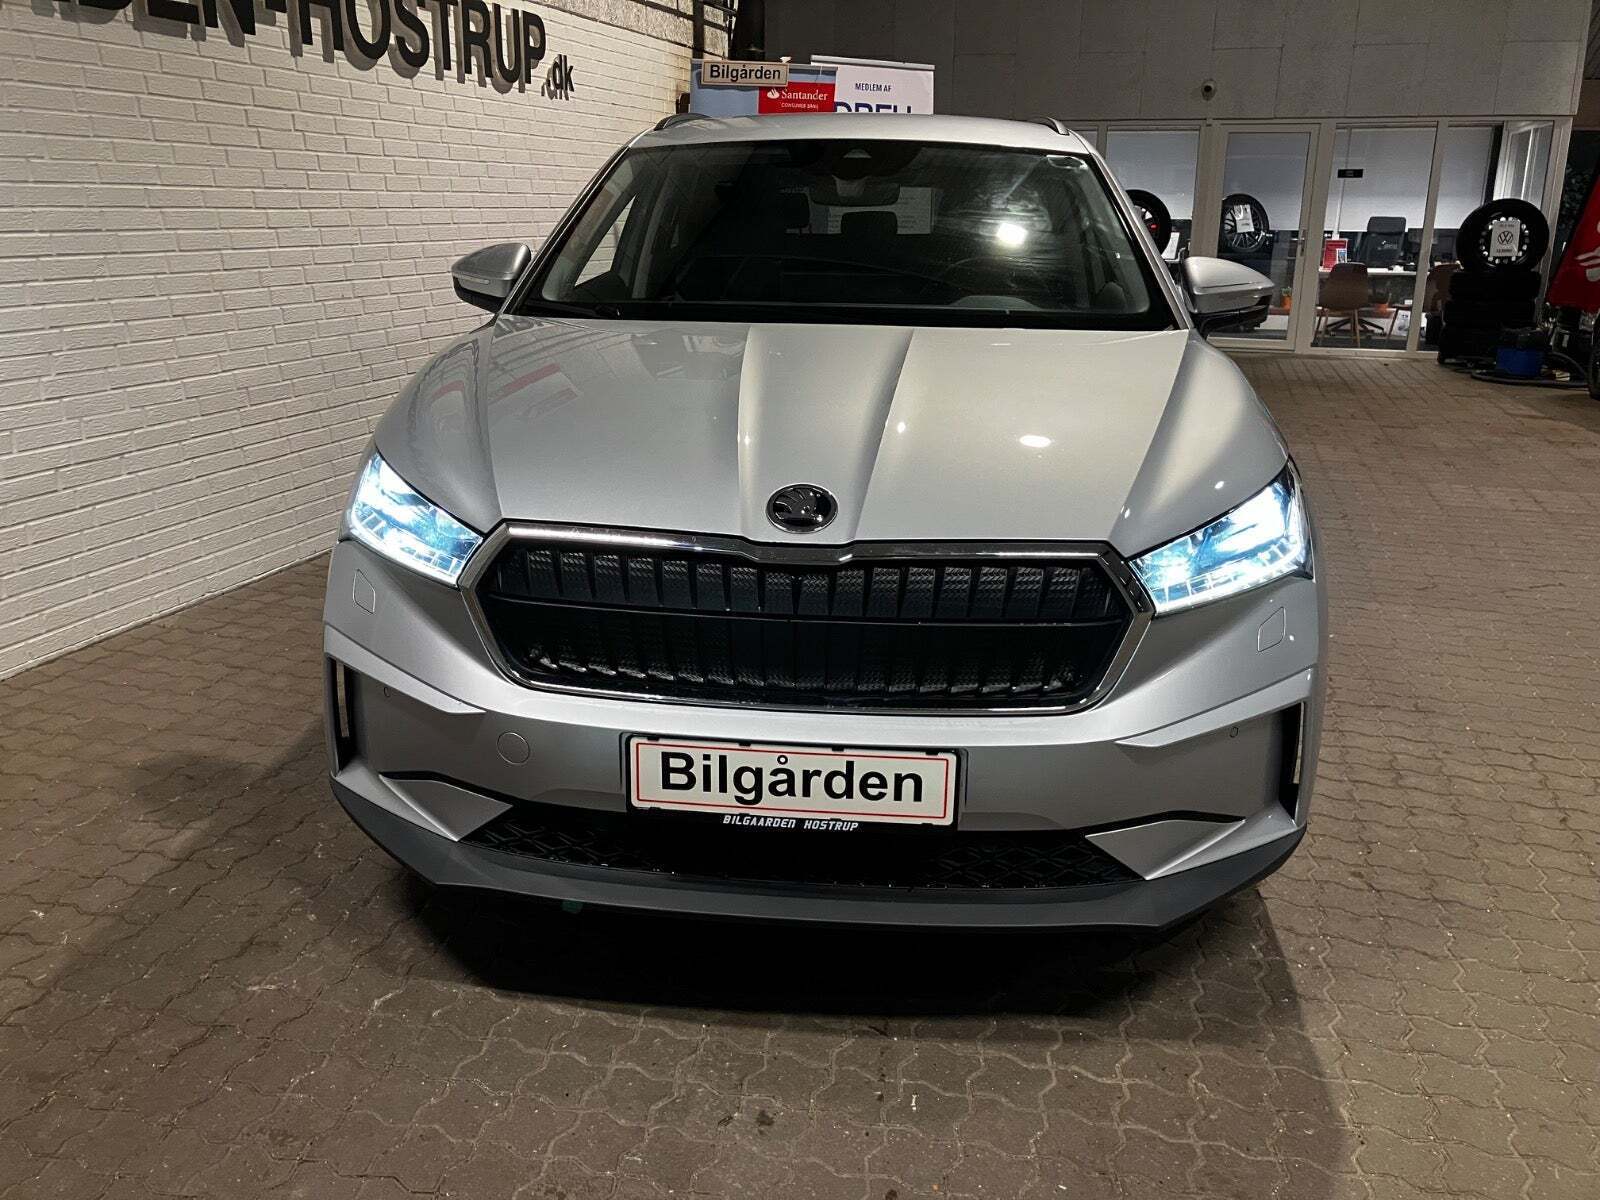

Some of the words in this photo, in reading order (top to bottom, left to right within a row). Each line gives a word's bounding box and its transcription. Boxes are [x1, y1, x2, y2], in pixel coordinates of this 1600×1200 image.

[710, 64, 781, 82] Bilgården
[781, 88, 828, 101] Santander
[855, 83, 882, 92] MEDLEM
[883, 85, 893, 93] AF
[660, 750, 924, 806] Bilgården
[722, 814, 797, 829] BILGAARDEN
[803, 818, 859, 831] HOSTRUP
